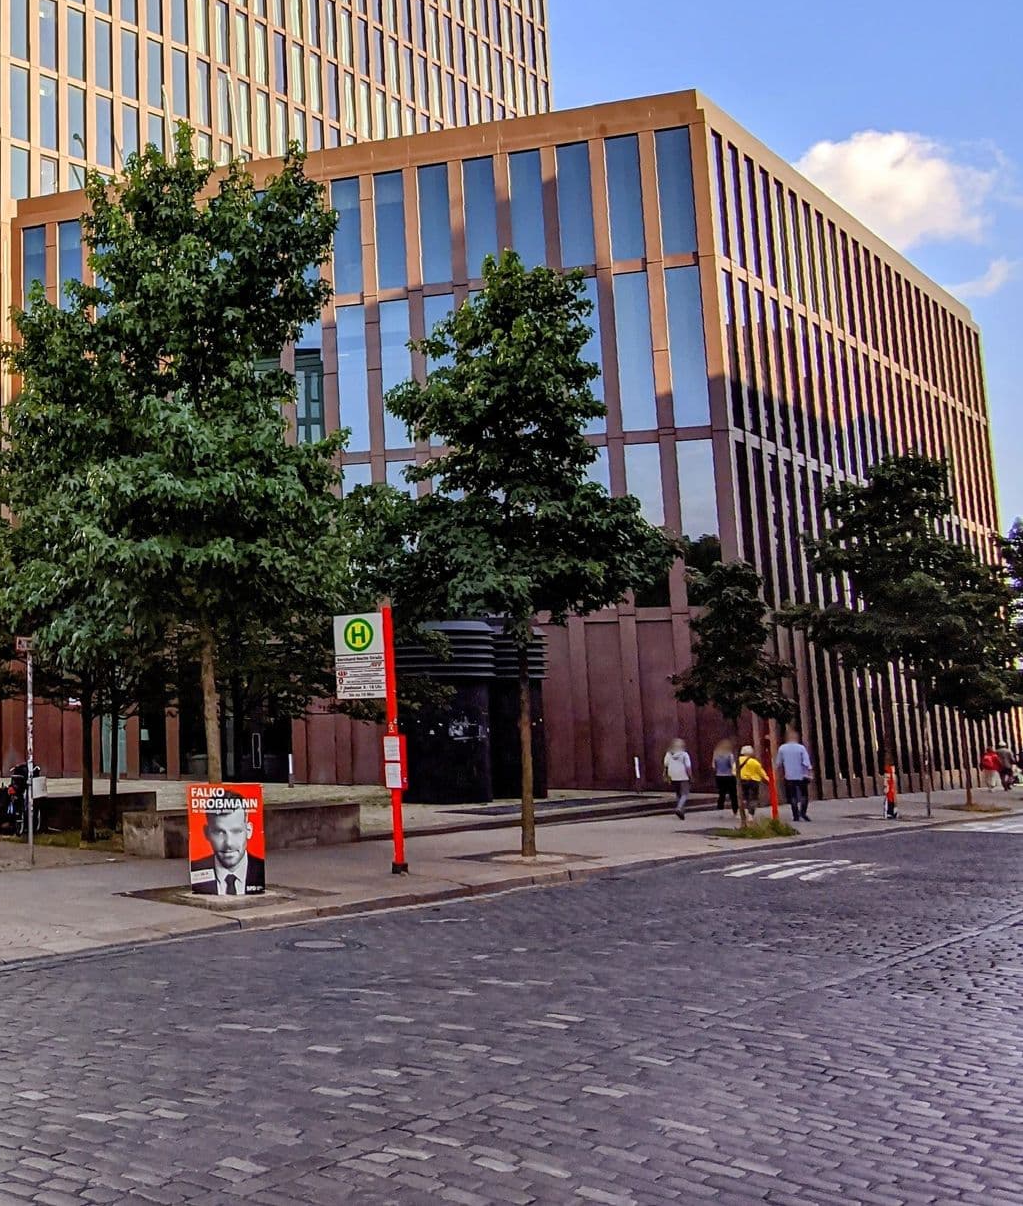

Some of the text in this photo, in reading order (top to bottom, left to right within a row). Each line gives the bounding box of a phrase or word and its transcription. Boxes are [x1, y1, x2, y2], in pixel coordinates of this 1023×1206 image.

[351, 625, 366, 644] H
[190, 787, 225, 798] FALKO
[191, 798, 259, 809] DROßMANN
